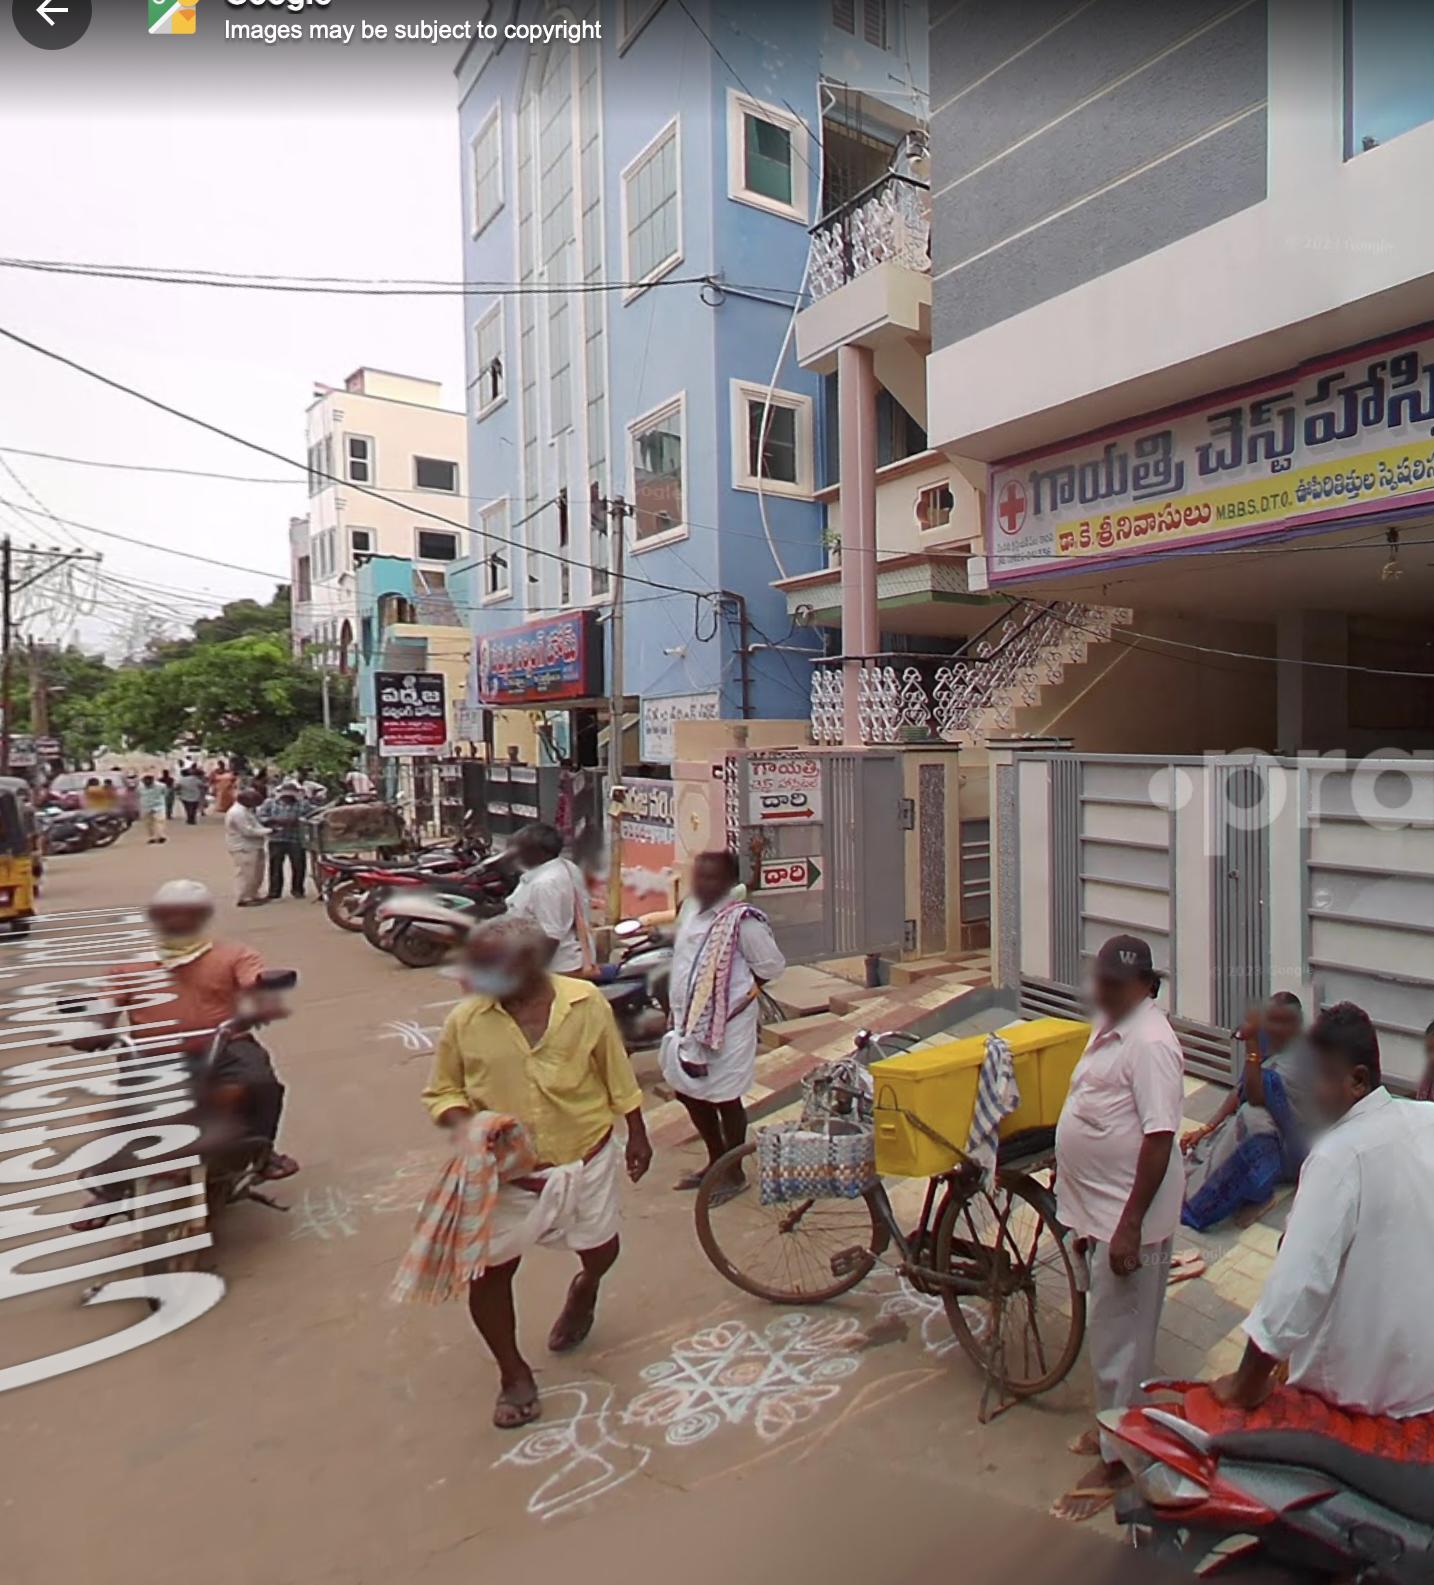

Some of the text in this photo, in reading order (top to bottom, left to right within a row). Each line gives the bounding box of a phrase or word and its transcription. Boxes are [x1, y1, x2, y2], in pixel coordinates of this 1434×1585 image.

[1029, 430, 1184, 515] గాయత్రి
[1195, 391, 1296, 477] చెస్ట్
[752, 760, 819, 778] గాయత్రి
[760, 792, 807, 808] దారి
[763, 865, 805, 884] దారి
[1120, 950, 1136, 964] W
